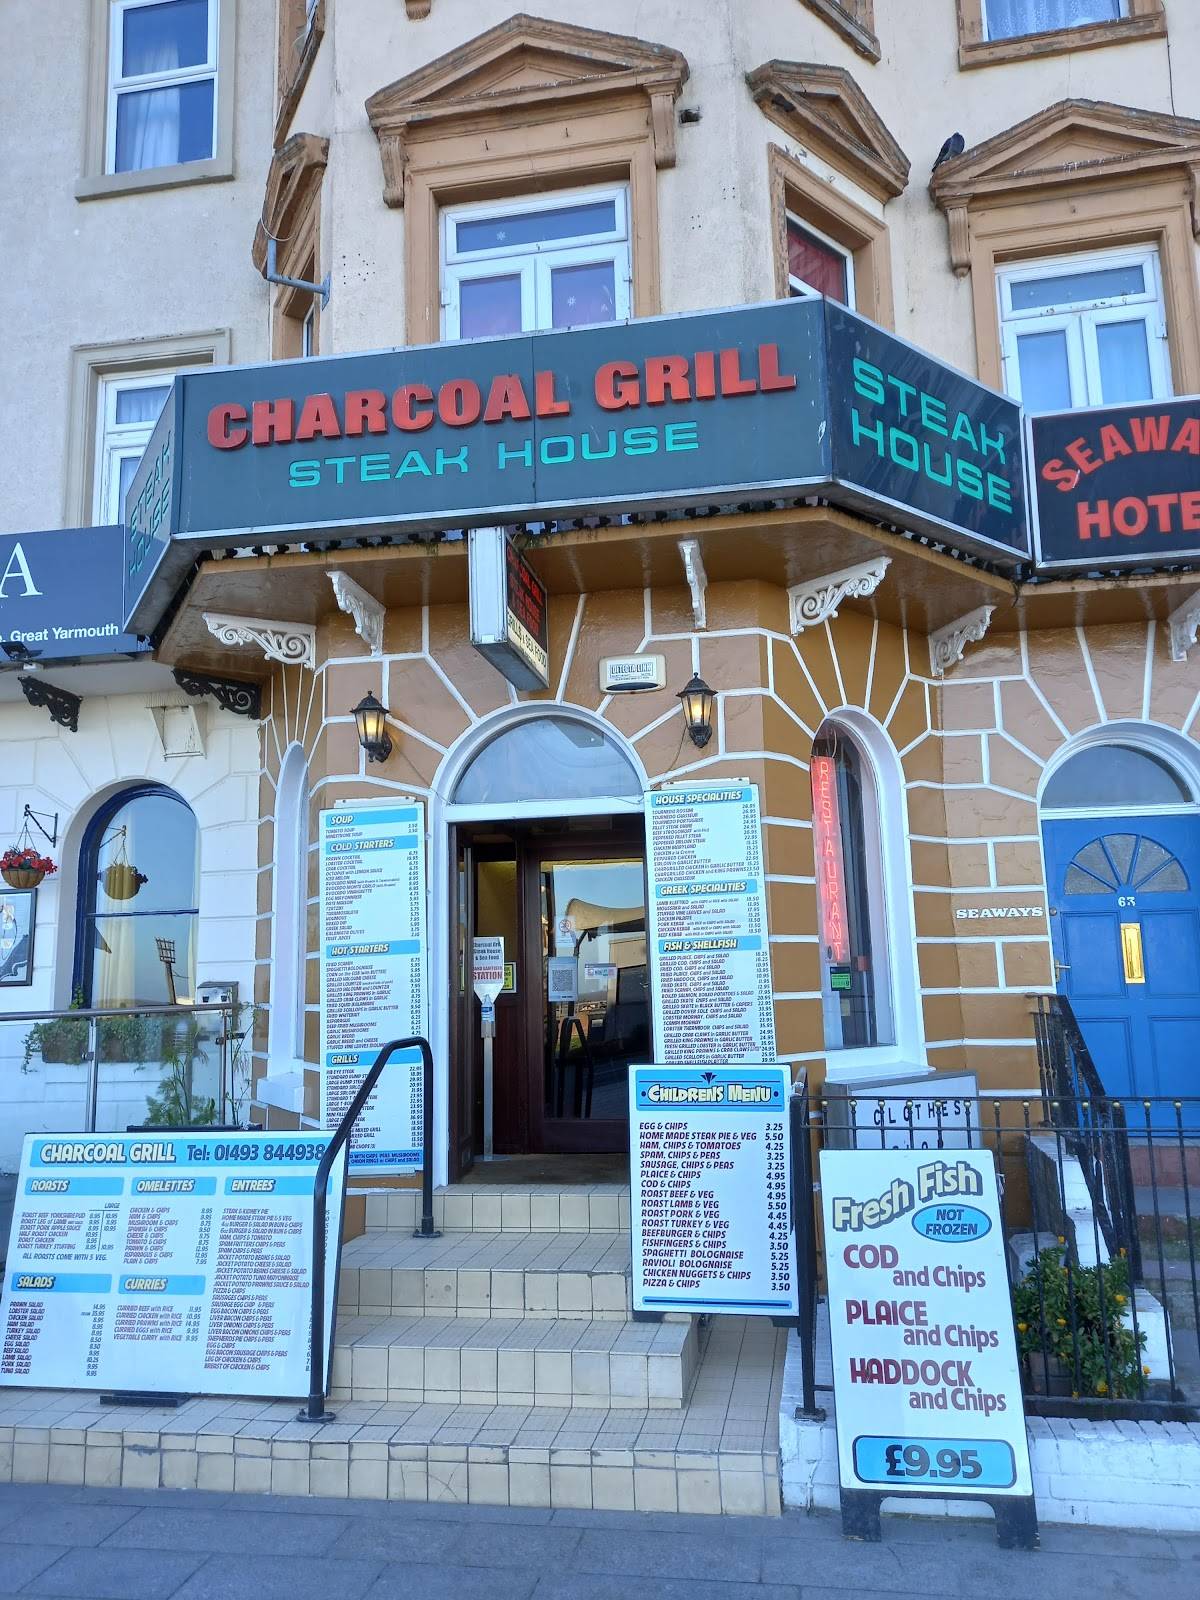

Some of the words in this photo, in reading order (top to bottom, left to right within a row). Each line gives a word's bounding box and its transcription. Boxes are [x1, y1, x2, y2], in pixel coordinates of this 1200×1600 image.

[207, 370, 570, 452] CHARCOAL
[594, 342, 797, 411] GRILL
[852, 356, 1006, 464] STEAK
[288, 445, 468, 488] STEAK
[497, 421, 699, 470] HOUSE
[851, 407, 1013, 514] HOUSE
[130, 429, 172, 543] STEAK
[129, 477, 170, 578] HOUSE
[10, 628, 49, 643] Great
[52, 623, 119, 641] Yarmouth
[655, 795, 686, 806] HOUSE
[686, 791, 743, 805] SPECIALITIES
[331, 815, 354, 826] SOUP
[330, 840, 353, 853] COLD
[354, 838, 395, 851] STARTERS
[820, 761, 842, 961] RESTAURANT
[660, 885, 690, 897] GREEK
[690, 881, 747, 895] SPECIALITIES
[1117, 896, 1137, 908] 63
[956, 906, 1043, 920] SEAWAYS
[332, 945, 351, 957] HOT
[350, 943, 390, 955] STARTERS
[663, 941, 684, 953] FISH
[684, 940, 692, 952] &
[692, 938, 739, 951] SHELLFISH
[472, 971, 503, 980] STATION
[331, 1054, 359, 1065] GRILLS
[718, 1132, 731, 1140] PIE
[40, 1142, 127, 1163] CHARCOAL
[129, 1142, 176, 1163] GRILL
[187, 1144, 210, 1161] Tel:
[214, 1144, 259, 1161] 01493
[263, 1144, 326, 1161] 844938
[639, 1141, 661, 1149] HAM,
[640, 1151, 665, 1159] SPAM,
[667, 1151, 691, 1159] CHIPS
[640, 1161, 678, 1169] SAUSAGE,
[681, 1161, 704, 1169] CHIPS
[640, 1170, 669, 1178] PLAICE
[766, 1172, 785, 1180] 4.95
[31, 1178, 70, 1193] ROASTS
[136, 1178, 196, 1193] OMELETTES
[231, 1178, 276, 1193] ENTREES
[766, 1182, 785, 1190] 4.95
[669, 1190, 688, 1198] BEEF
[766, 1192, 786, 1200] 4.95
[832, 1178, 914, 1232] Fresh
[916, 1161, 983, 1203] Fish
[641, 1199, 668, 1207] ROAST
[670, 1200, 693, 1208] LAMB
[767, 1202, 786, 1210] 5.50
[641, 1209, 669, 1217] ROAST
[767, 1212, 786, 1220] 4.45
[936, 1208, 964, 1222] NOT
[641, 1219, 669, 1227] ROAST
[671, 1220, 703, 1228] TURKEY
[768, 1222, 787, 1230] 4.45
[925, 1222, 978, 1236] FROZEN
[641, 1229, 692, 1237] BEEFBURGER
[702, 1230, 726, 1238] CHIPS
[768, 1232, 787, 1240] 4.25
[642, 1239, 693, 1247] FISHFINGERS
[702, 1240, 726, 1248] CHIPS
[642, 1248, 687, 1257] SPAGHETTI
[690, 1250, 743, 1259] BOLOGNAISE
[843, 1244, 899, 1269] COD
[642, 1258, 675, 1266] RAVIOLI
[679, 1259, 732, 1269] BOLOGNAISE
[771, 1263, 789, 1271] 5.25
[642, 1268, 678, 1276] CHICKEN
[679, 1269, 717, 1278] NUGGETS
[727, 1271, 751, 1279] CHIPS
[770, 1273, 789, 1281] 3.50
[892, 1266, 930, 1287] and
[932, 1265, 986, 1293] Chips
[16, 1275, 56, 1290] SALADS
[124, 1278, 168, 1293] CURRIES
[643, 1278, 666, 1286] PIZZA
[676, 1279, 700, 1287] CHIPS
[771, 1283, 790, 1291] 3.50
[845, 1300, 929, 1326] PLAICE
[903, 1325, 942, 1346] and
[944, 1324, 999, 1353] Chips
[849, 1357, 975, 1388] HADDOCK
[908, 1387, 949, 1410] and
[951, 1387, 1007, 1416] Chips
[885, 1443, 983, 1479] £9.95
